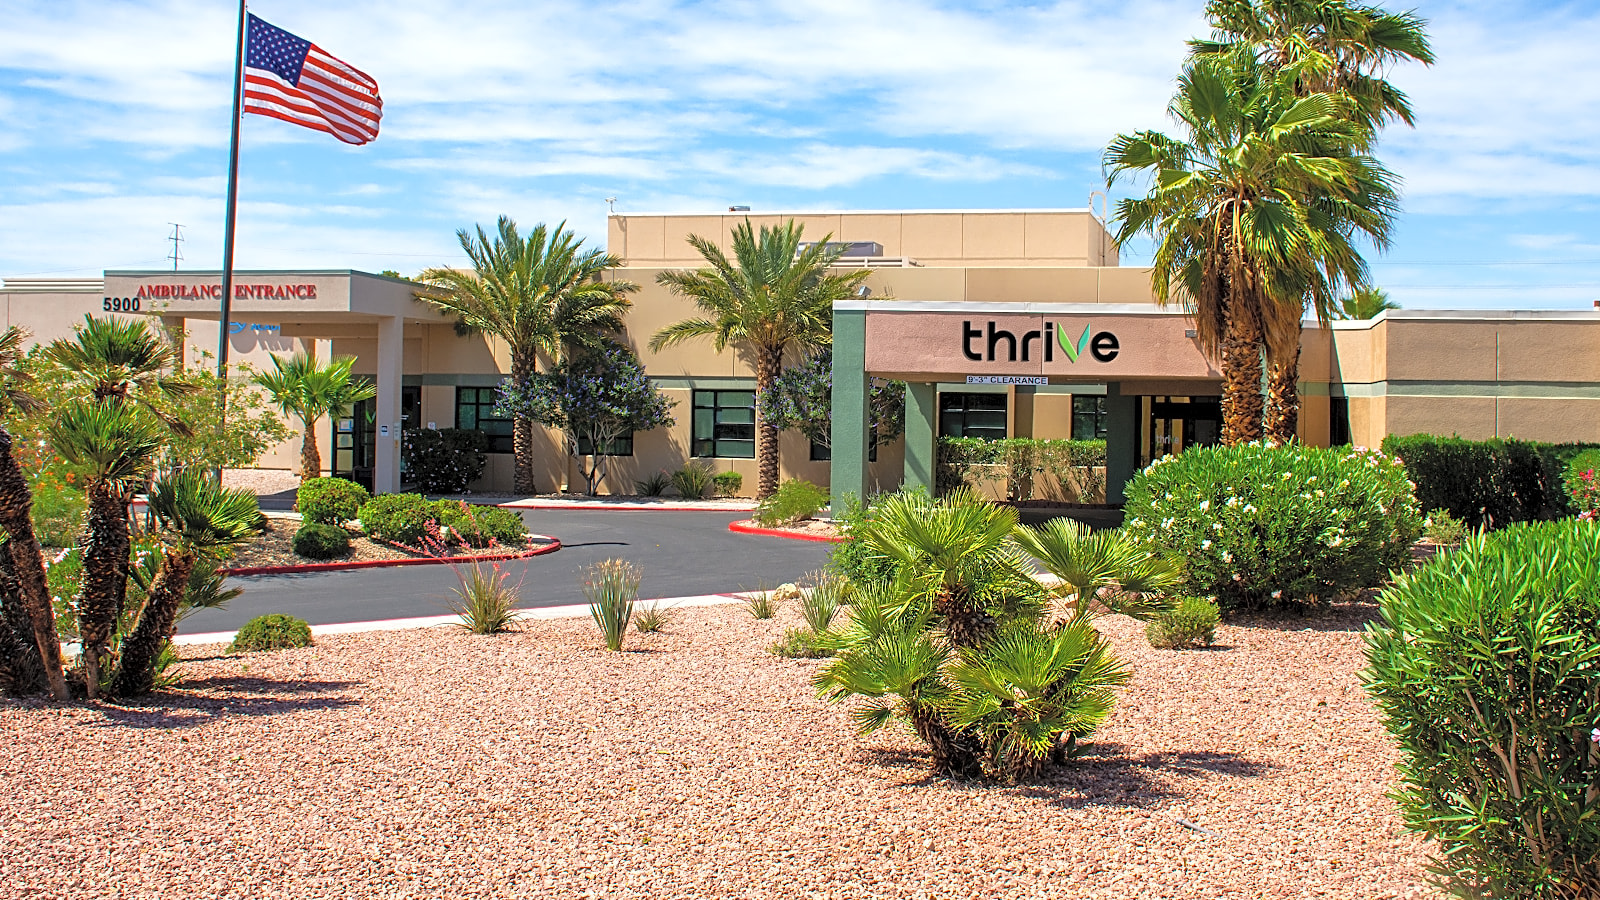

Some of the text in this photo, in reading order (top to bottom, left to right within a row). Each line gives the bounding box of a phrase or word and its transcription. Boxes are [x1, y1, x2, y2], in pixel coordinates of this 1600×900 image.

[137, 284, 317, 298] AMBULANC ENTRANCE
[103, 297, 140, 311] 5900
[962, 320, 1120, 364] thrive
[990, 376, 1047, 385] CLEARANCE
